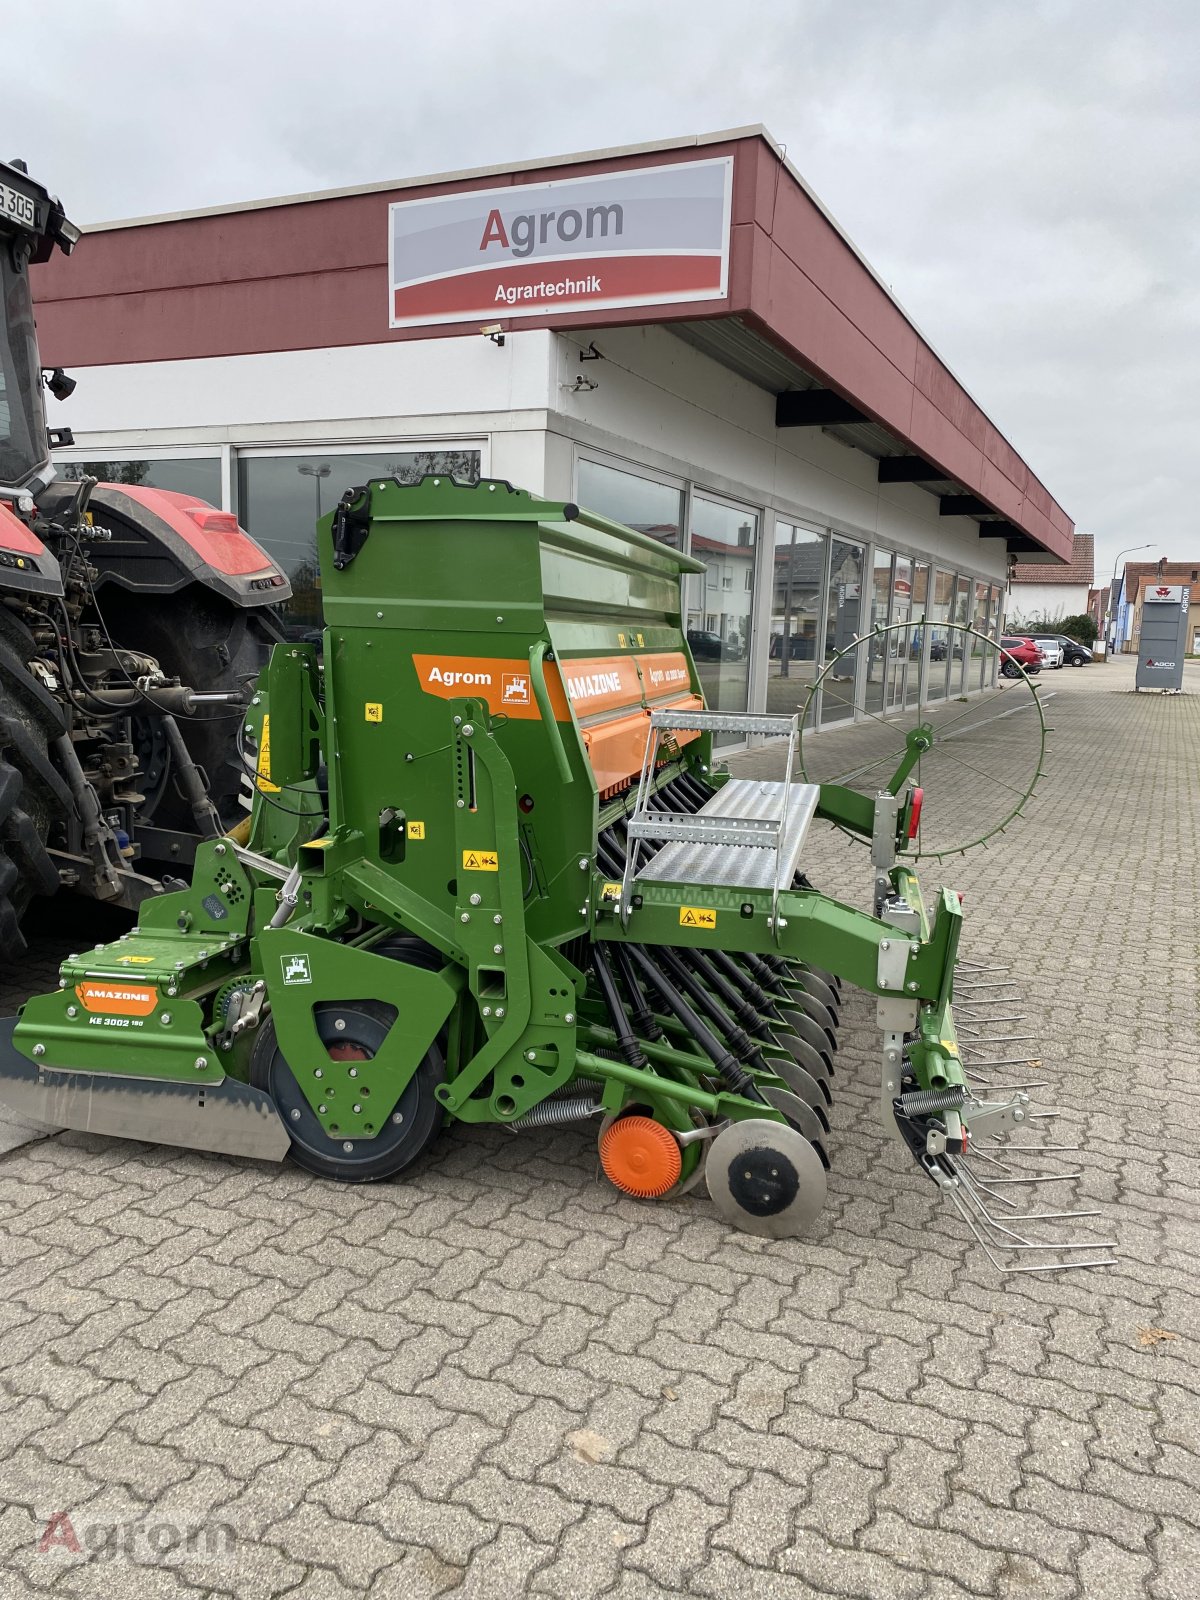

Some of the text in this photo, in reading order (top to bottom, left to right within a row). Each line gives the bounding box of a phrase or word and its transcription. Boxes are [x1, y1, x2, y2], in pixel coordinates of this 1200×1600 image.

[8, 190, 33, 222] 305
[479, 203, 624, 257] Agrom
[494, 276, 601, 304] Agrartechnik
[1181, 588, 1190, 614] AGROM
[428, 666, 492, 687] Agrom
[567, 672, 622, 699] AMAZONE
[85, 989, 150, 1002] AMAZONE
[89, 1017, 102, 1025] KE
[103, 1018, 129, 1027] 3002
